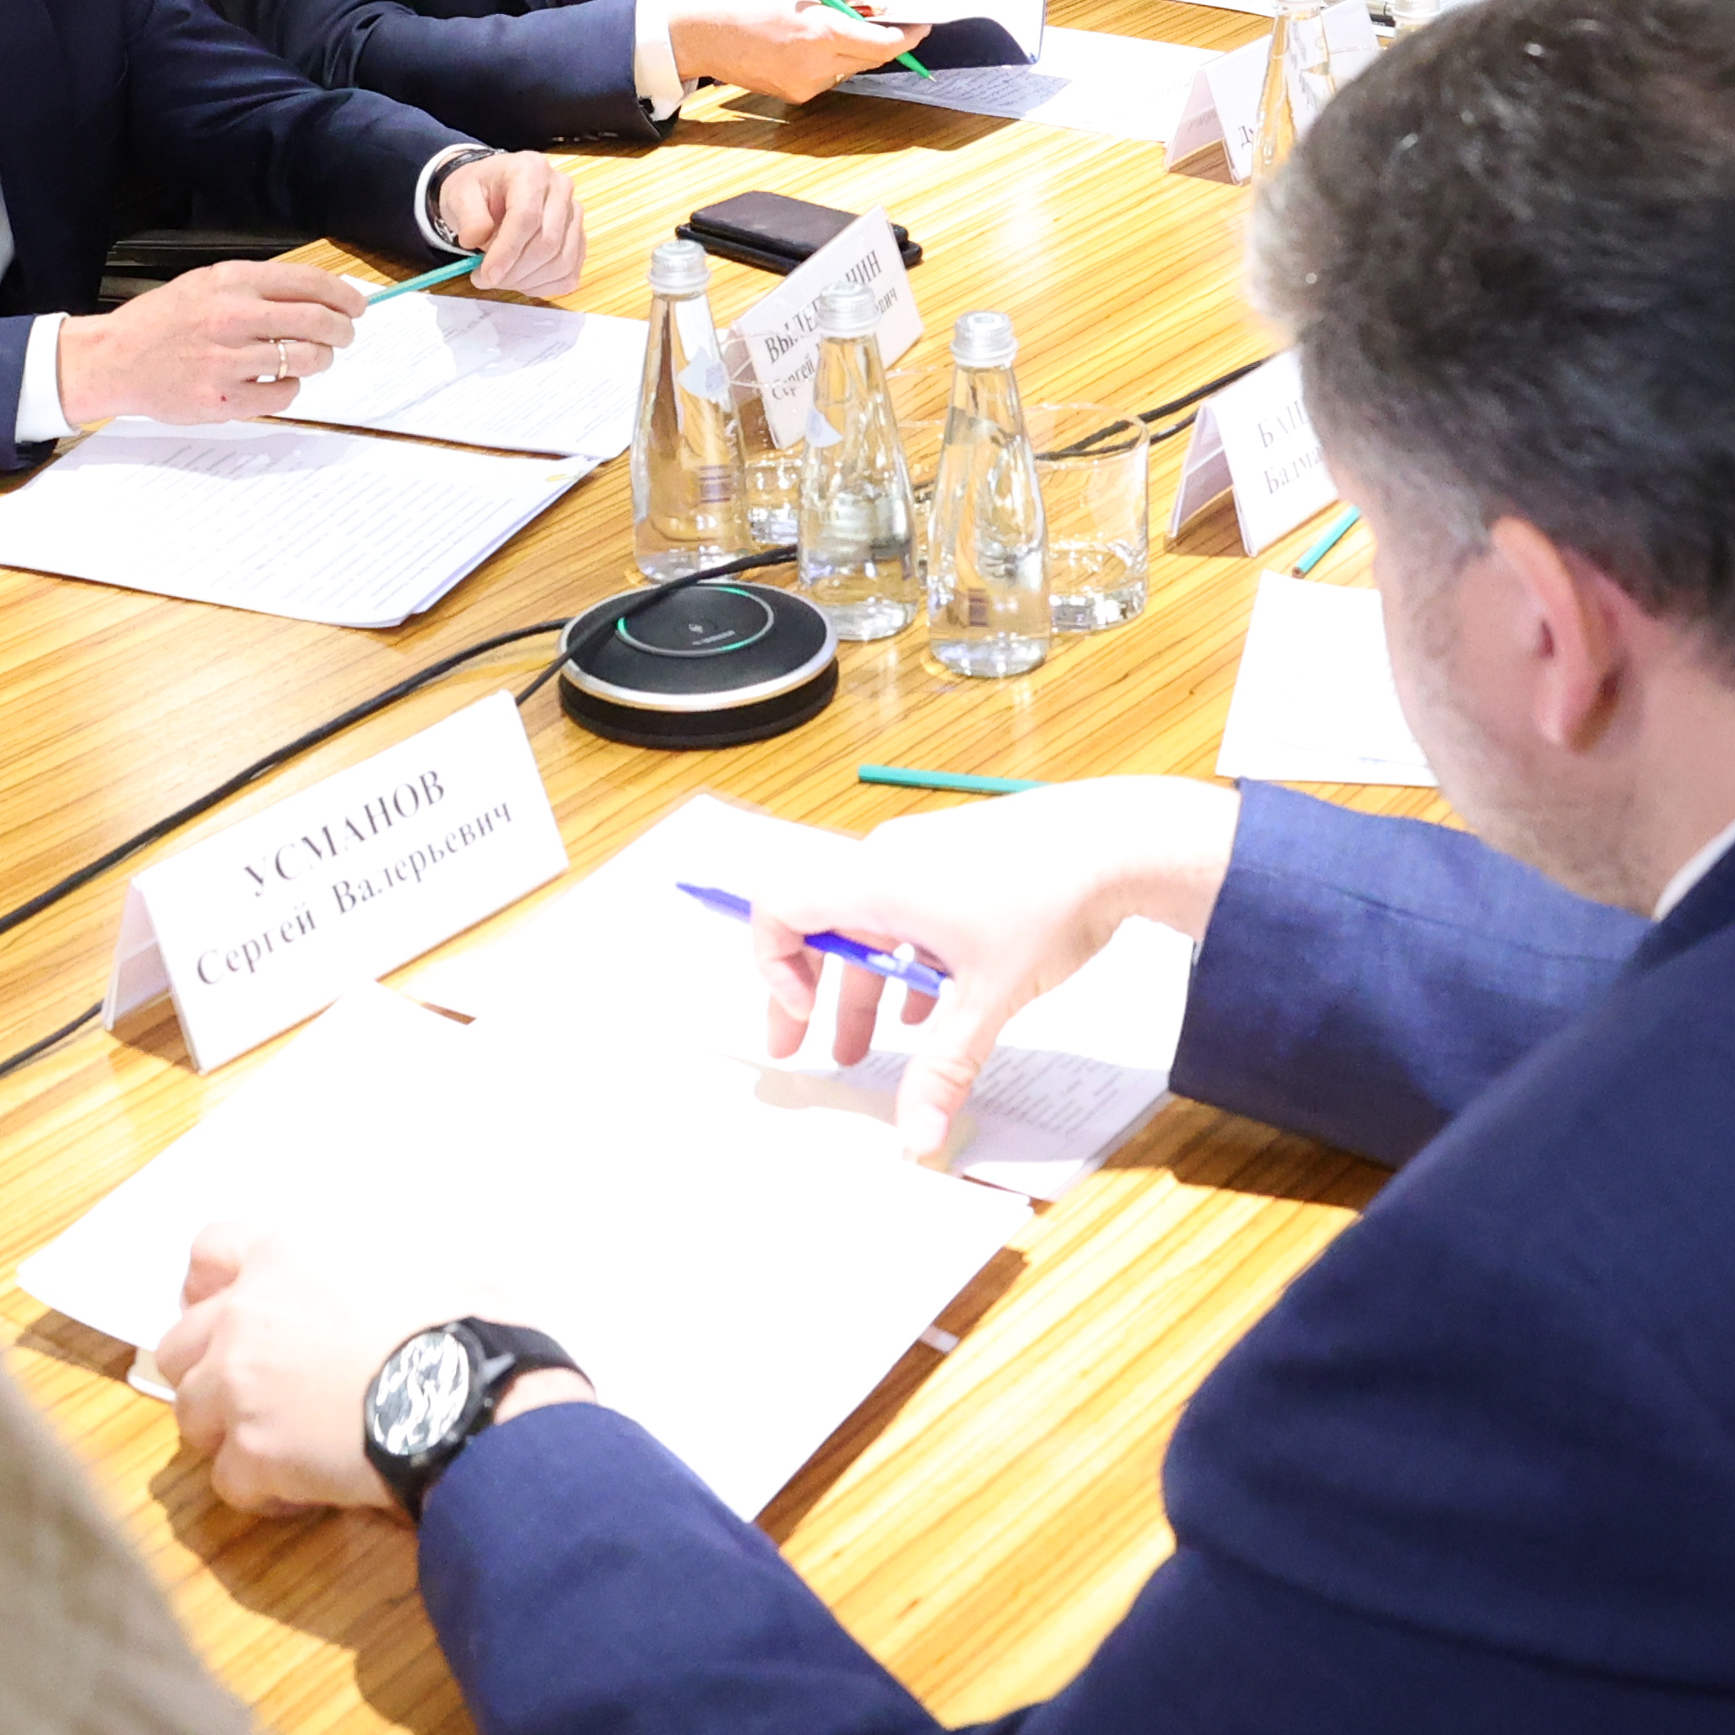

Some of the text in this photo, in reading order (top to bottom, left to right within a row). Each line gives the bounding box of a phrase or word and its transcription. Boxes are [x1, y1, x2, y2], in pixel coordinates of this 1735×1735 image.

[196, 801, 513, 986] Сергей Валерьевич
[243, 769, 446, 898] УСМАНОВ
